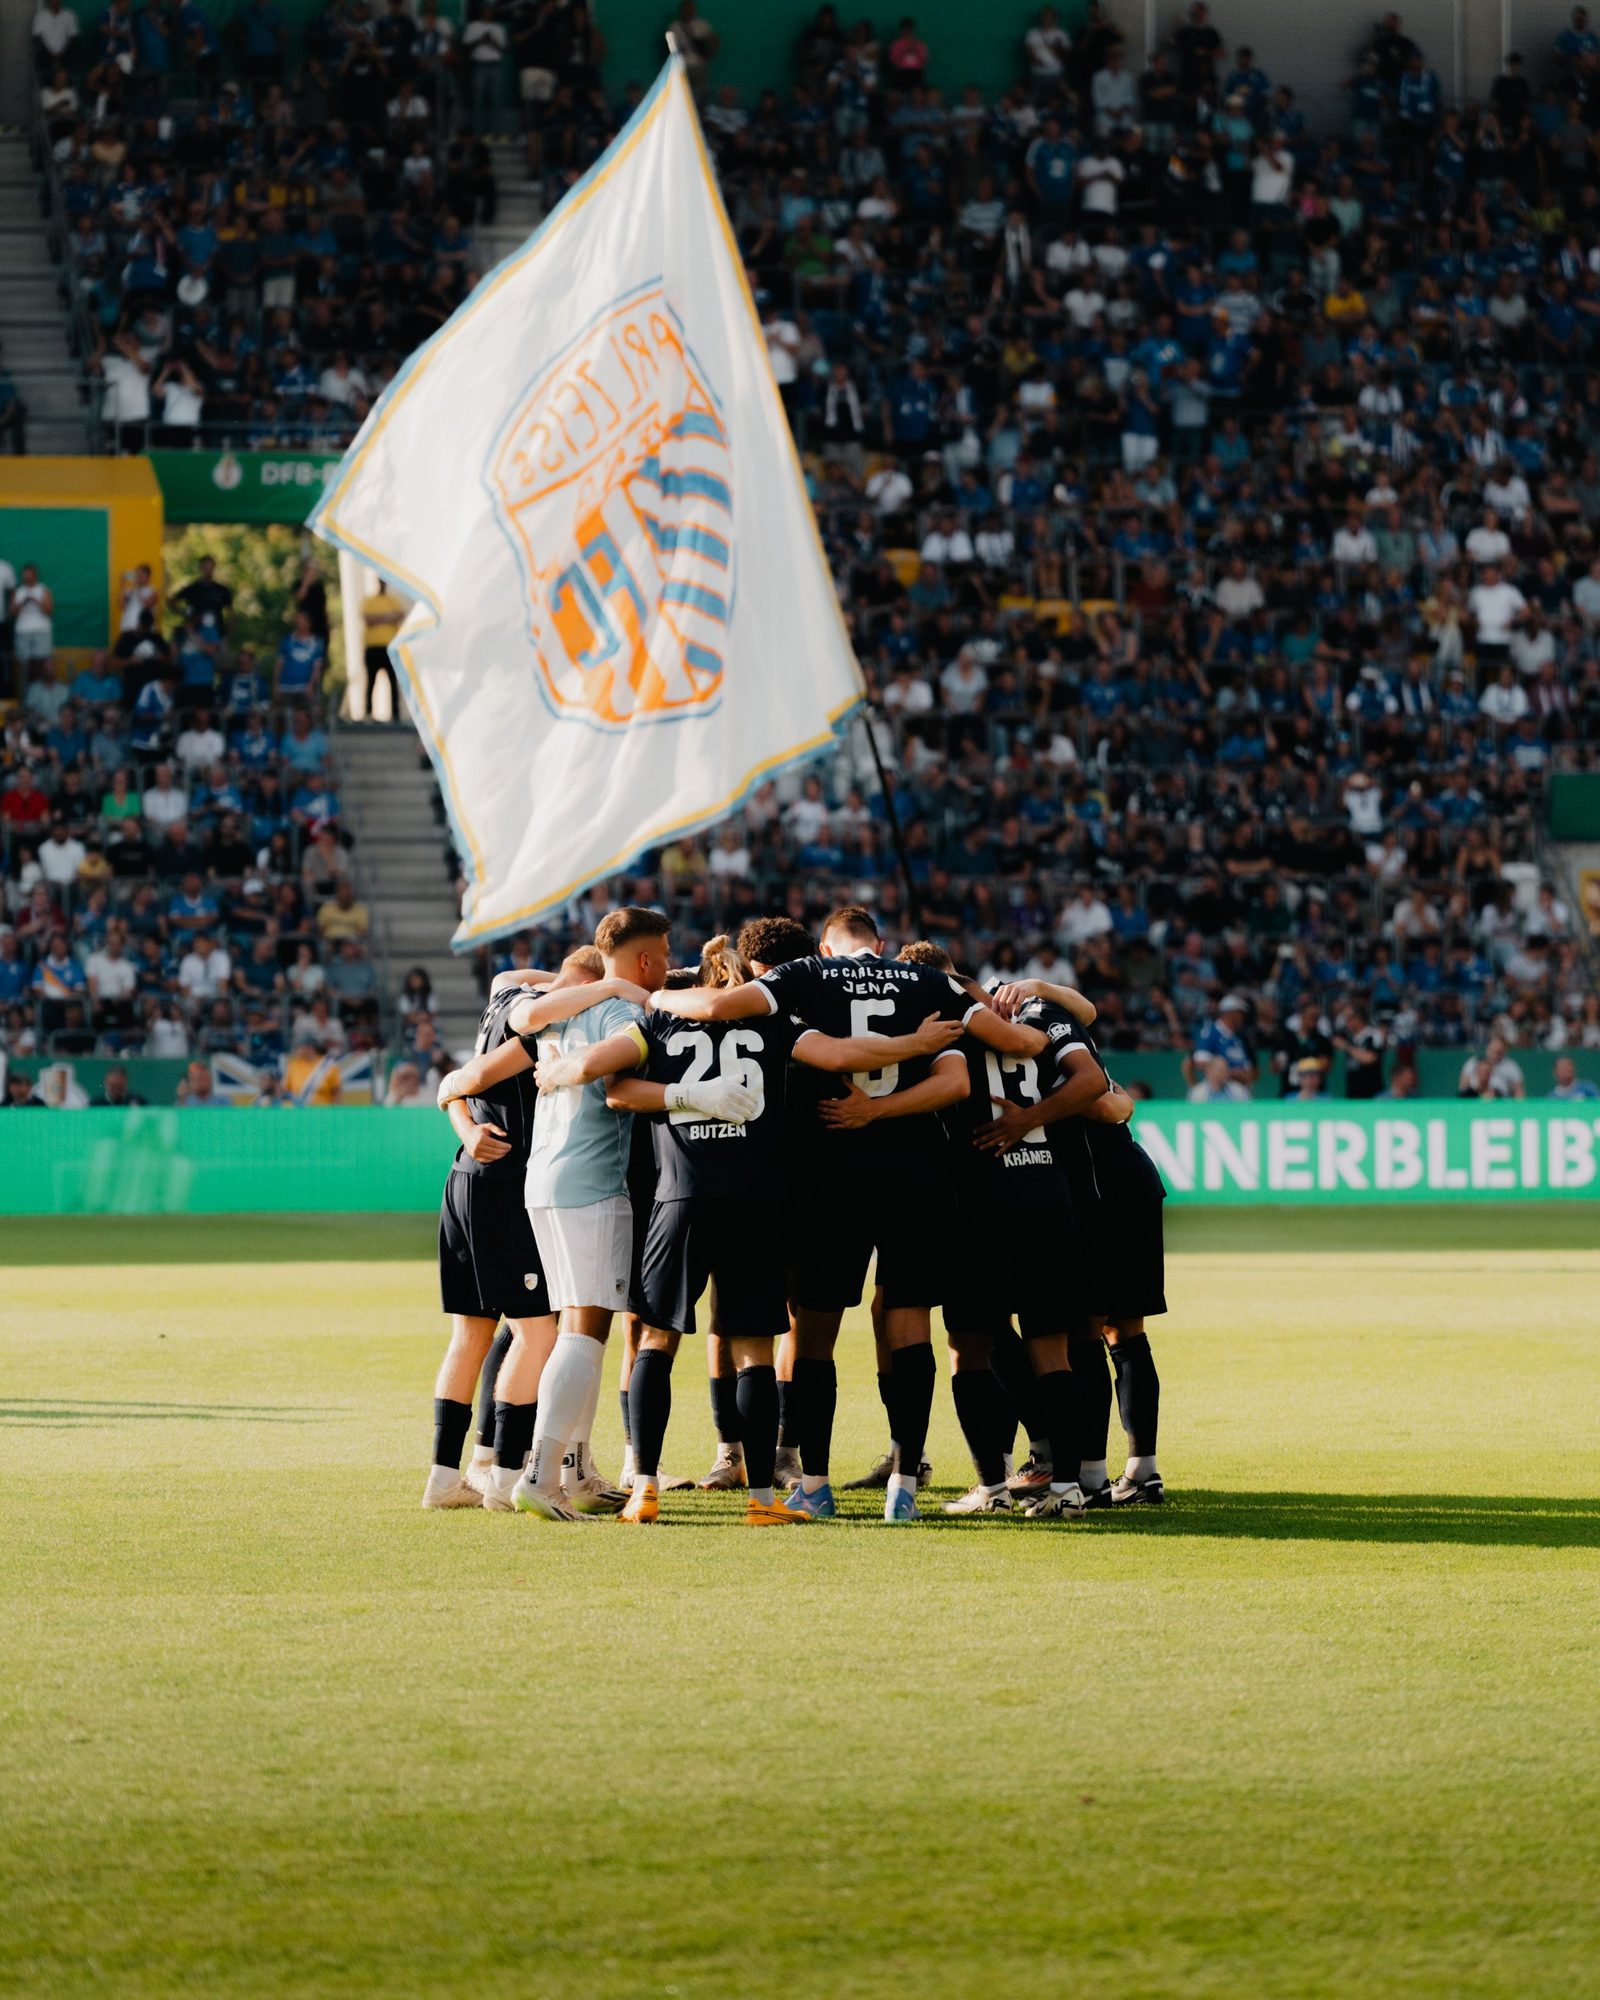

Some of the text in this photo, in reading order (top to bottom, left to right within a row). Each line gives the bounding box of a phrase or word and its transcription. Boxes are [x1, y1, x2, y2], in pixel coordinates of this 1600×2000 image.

[822, 968, 839, 980] FC
[842, 980, 900, 995] JENA
[850, 998, 899, 1098] 5
[666, 1028, 766, 1126] 26
[984, 1050, 1048, 1144] 13
[689, 1123, 747, 1140] BUTZEN
[1136, 1117, 1600, 1191] NNERBLEIB
[1003, 1148, 1053, 1168] KRÄMER
